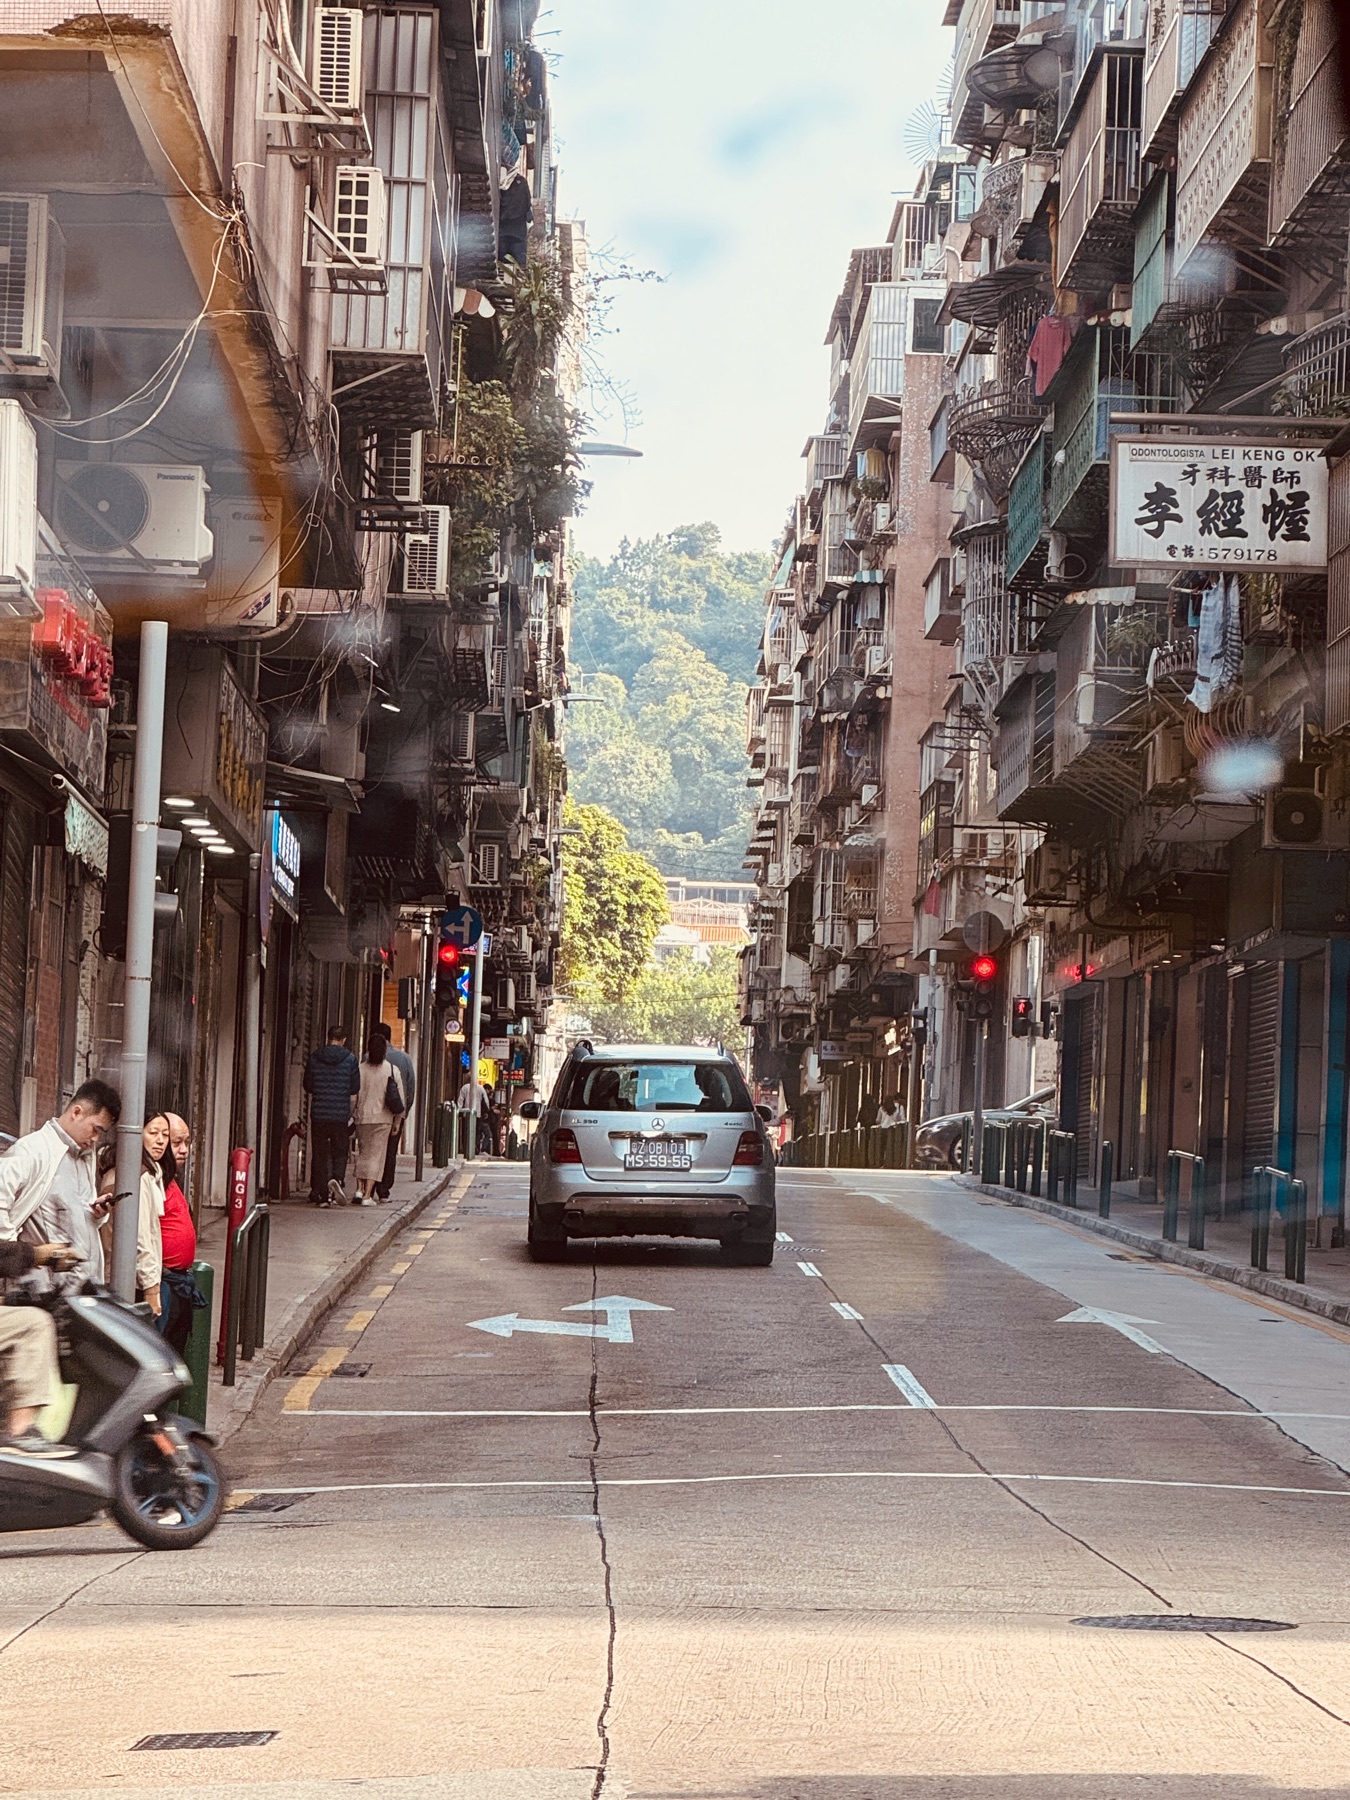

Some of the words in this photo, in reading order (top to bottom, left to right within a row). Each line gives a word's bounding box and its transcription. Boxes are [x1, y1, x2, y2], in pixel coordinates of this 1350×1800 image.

[1131, 448, 1205, 458] ODONTOLOGISTA
[1212, 448, 1235, 460] LEI
[1242, 450, 1285, 461] KENG
[1293, 451, 1316, 462] OK
[157, 473, 195, 481] Panasonic
[1178, 464, 1301, 490] 牙科醫師
[1134, 482, 1311, 542] 李經幄
[626, 1155, 690, 1168] MS-59-56
